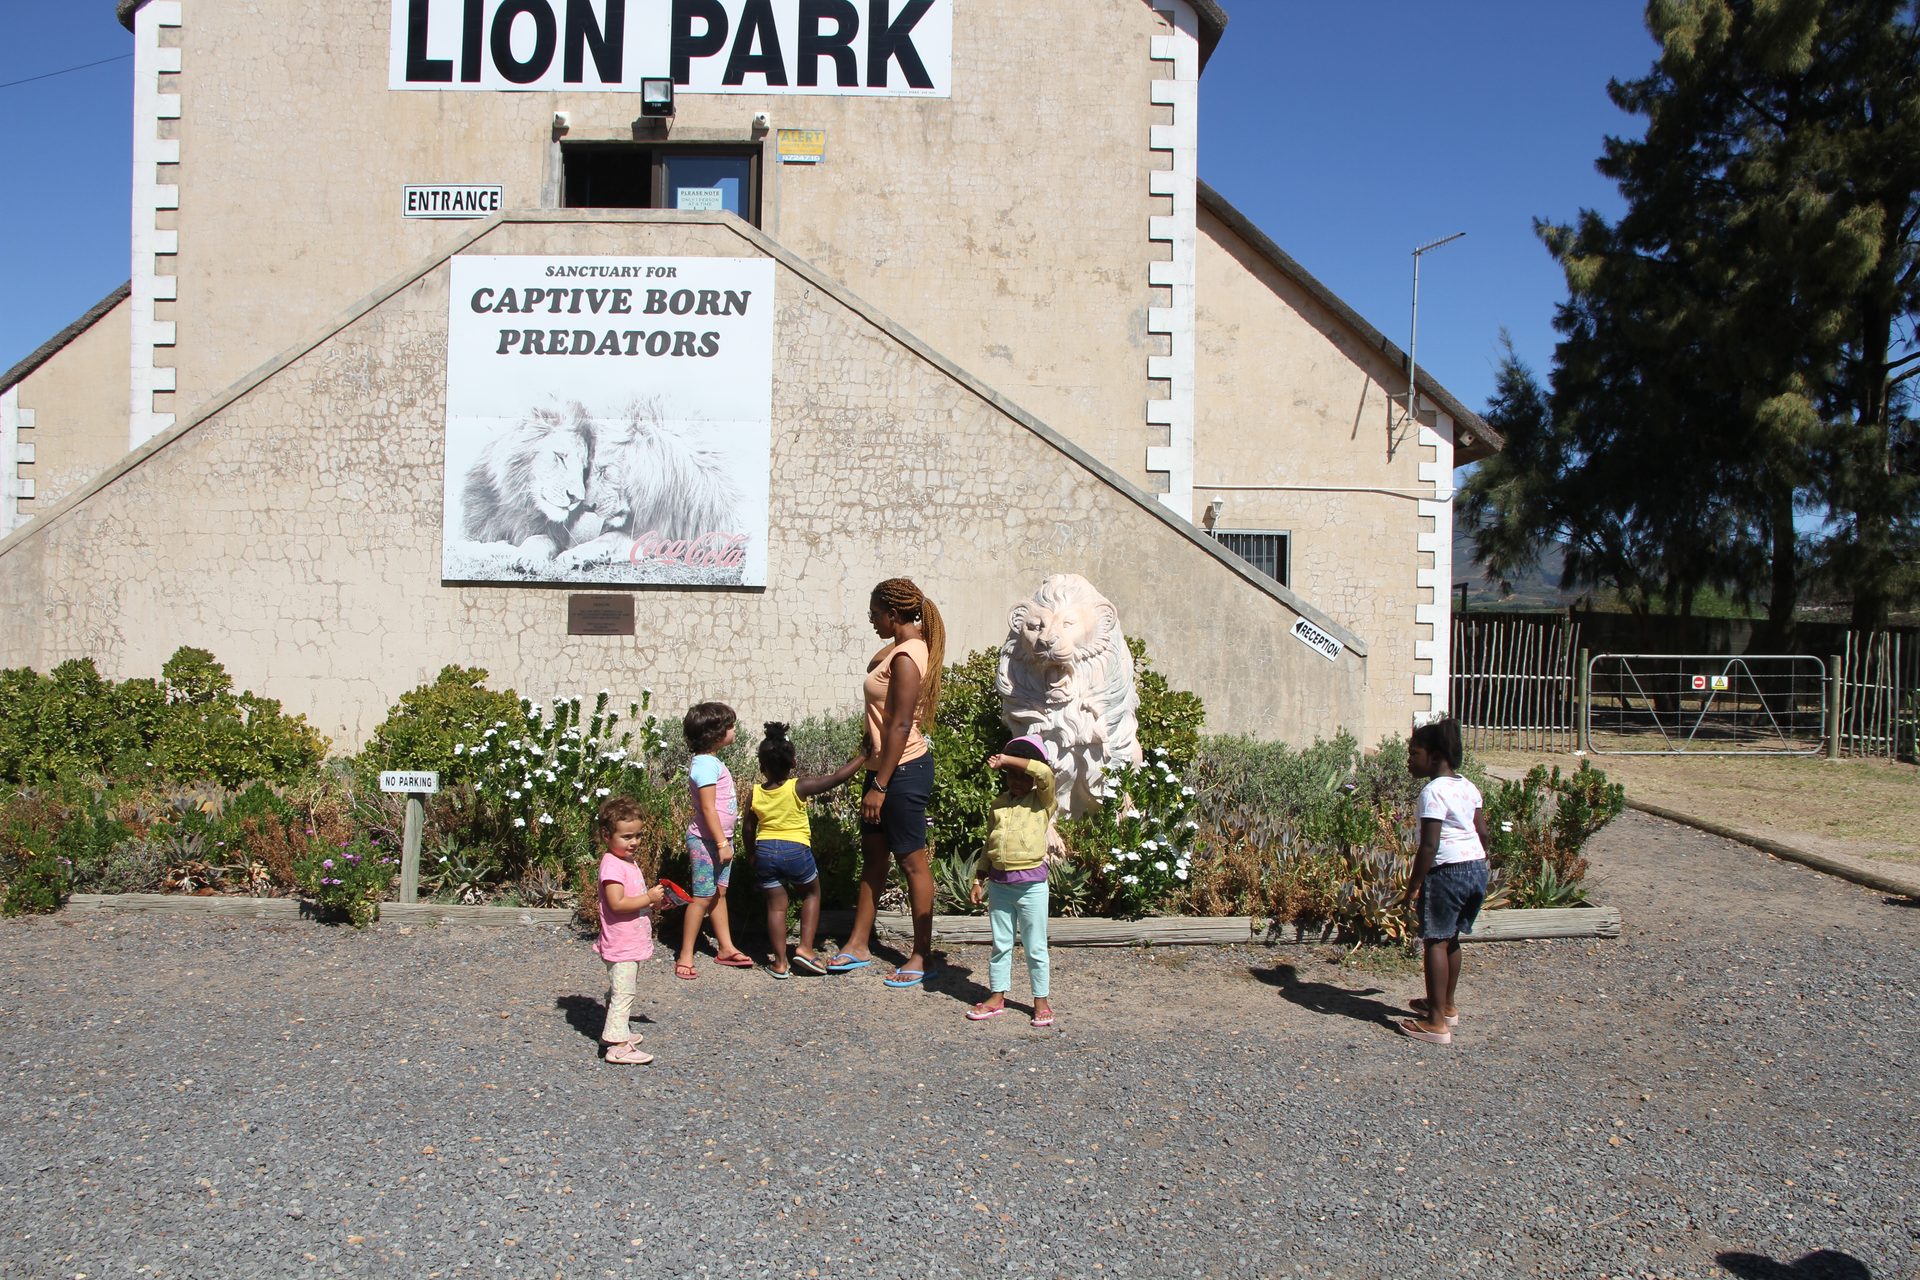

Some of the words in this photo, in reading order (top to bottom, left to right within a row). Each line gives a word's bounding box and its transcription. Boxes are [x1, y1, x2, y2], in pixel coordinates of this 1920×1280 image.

[405, 0, 625, 85] LION
[670, 0, 936, 89] PARK
[781, 131, 821, 143] ALERT
[408, 191, 499, 211] ENTRANCE
[545, 265, 641, 278] SANCTUARY
[646, 266, 677, 279] FOR
[470, 287, 633, 315] CAPTIVE
[642, 289, 752, 317] BORN
[496, 329, 721, 358] PREDATORS
[1300, 625, 1340, 657] RECEPTION
[385, 776, 396, 786] NO
[399, 777, 432, 787] PARKING
